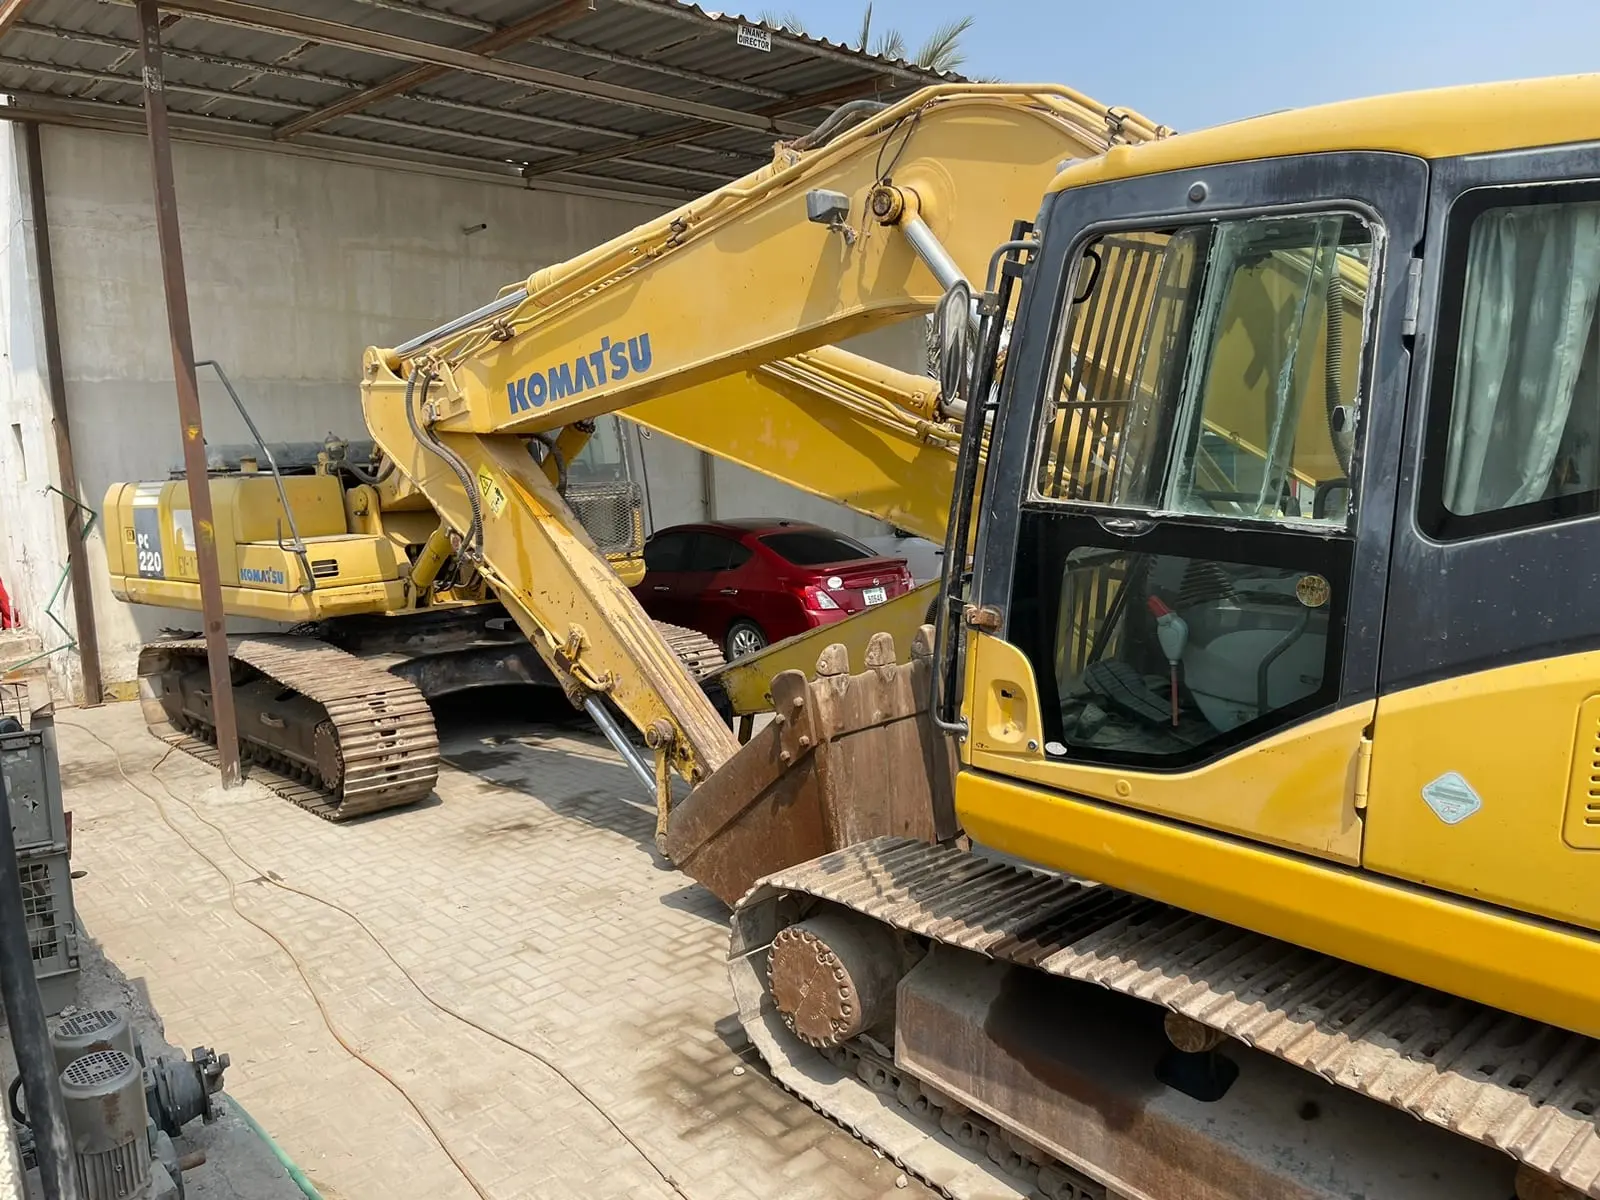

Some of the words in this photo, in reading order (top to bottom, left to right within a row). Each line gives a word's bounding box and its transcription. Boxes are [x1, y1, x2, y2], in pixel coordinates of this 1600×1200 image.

[741, 26, 767, 40] FINANCE
[739, 35, 770, 50] DIRECTOR
[507, 333, 652, 415] KOMATSU
[137, 533, 150, 549] PC
[139, 551, 162, 572] 220
[240, 566, 284, 584] KOMATSU
